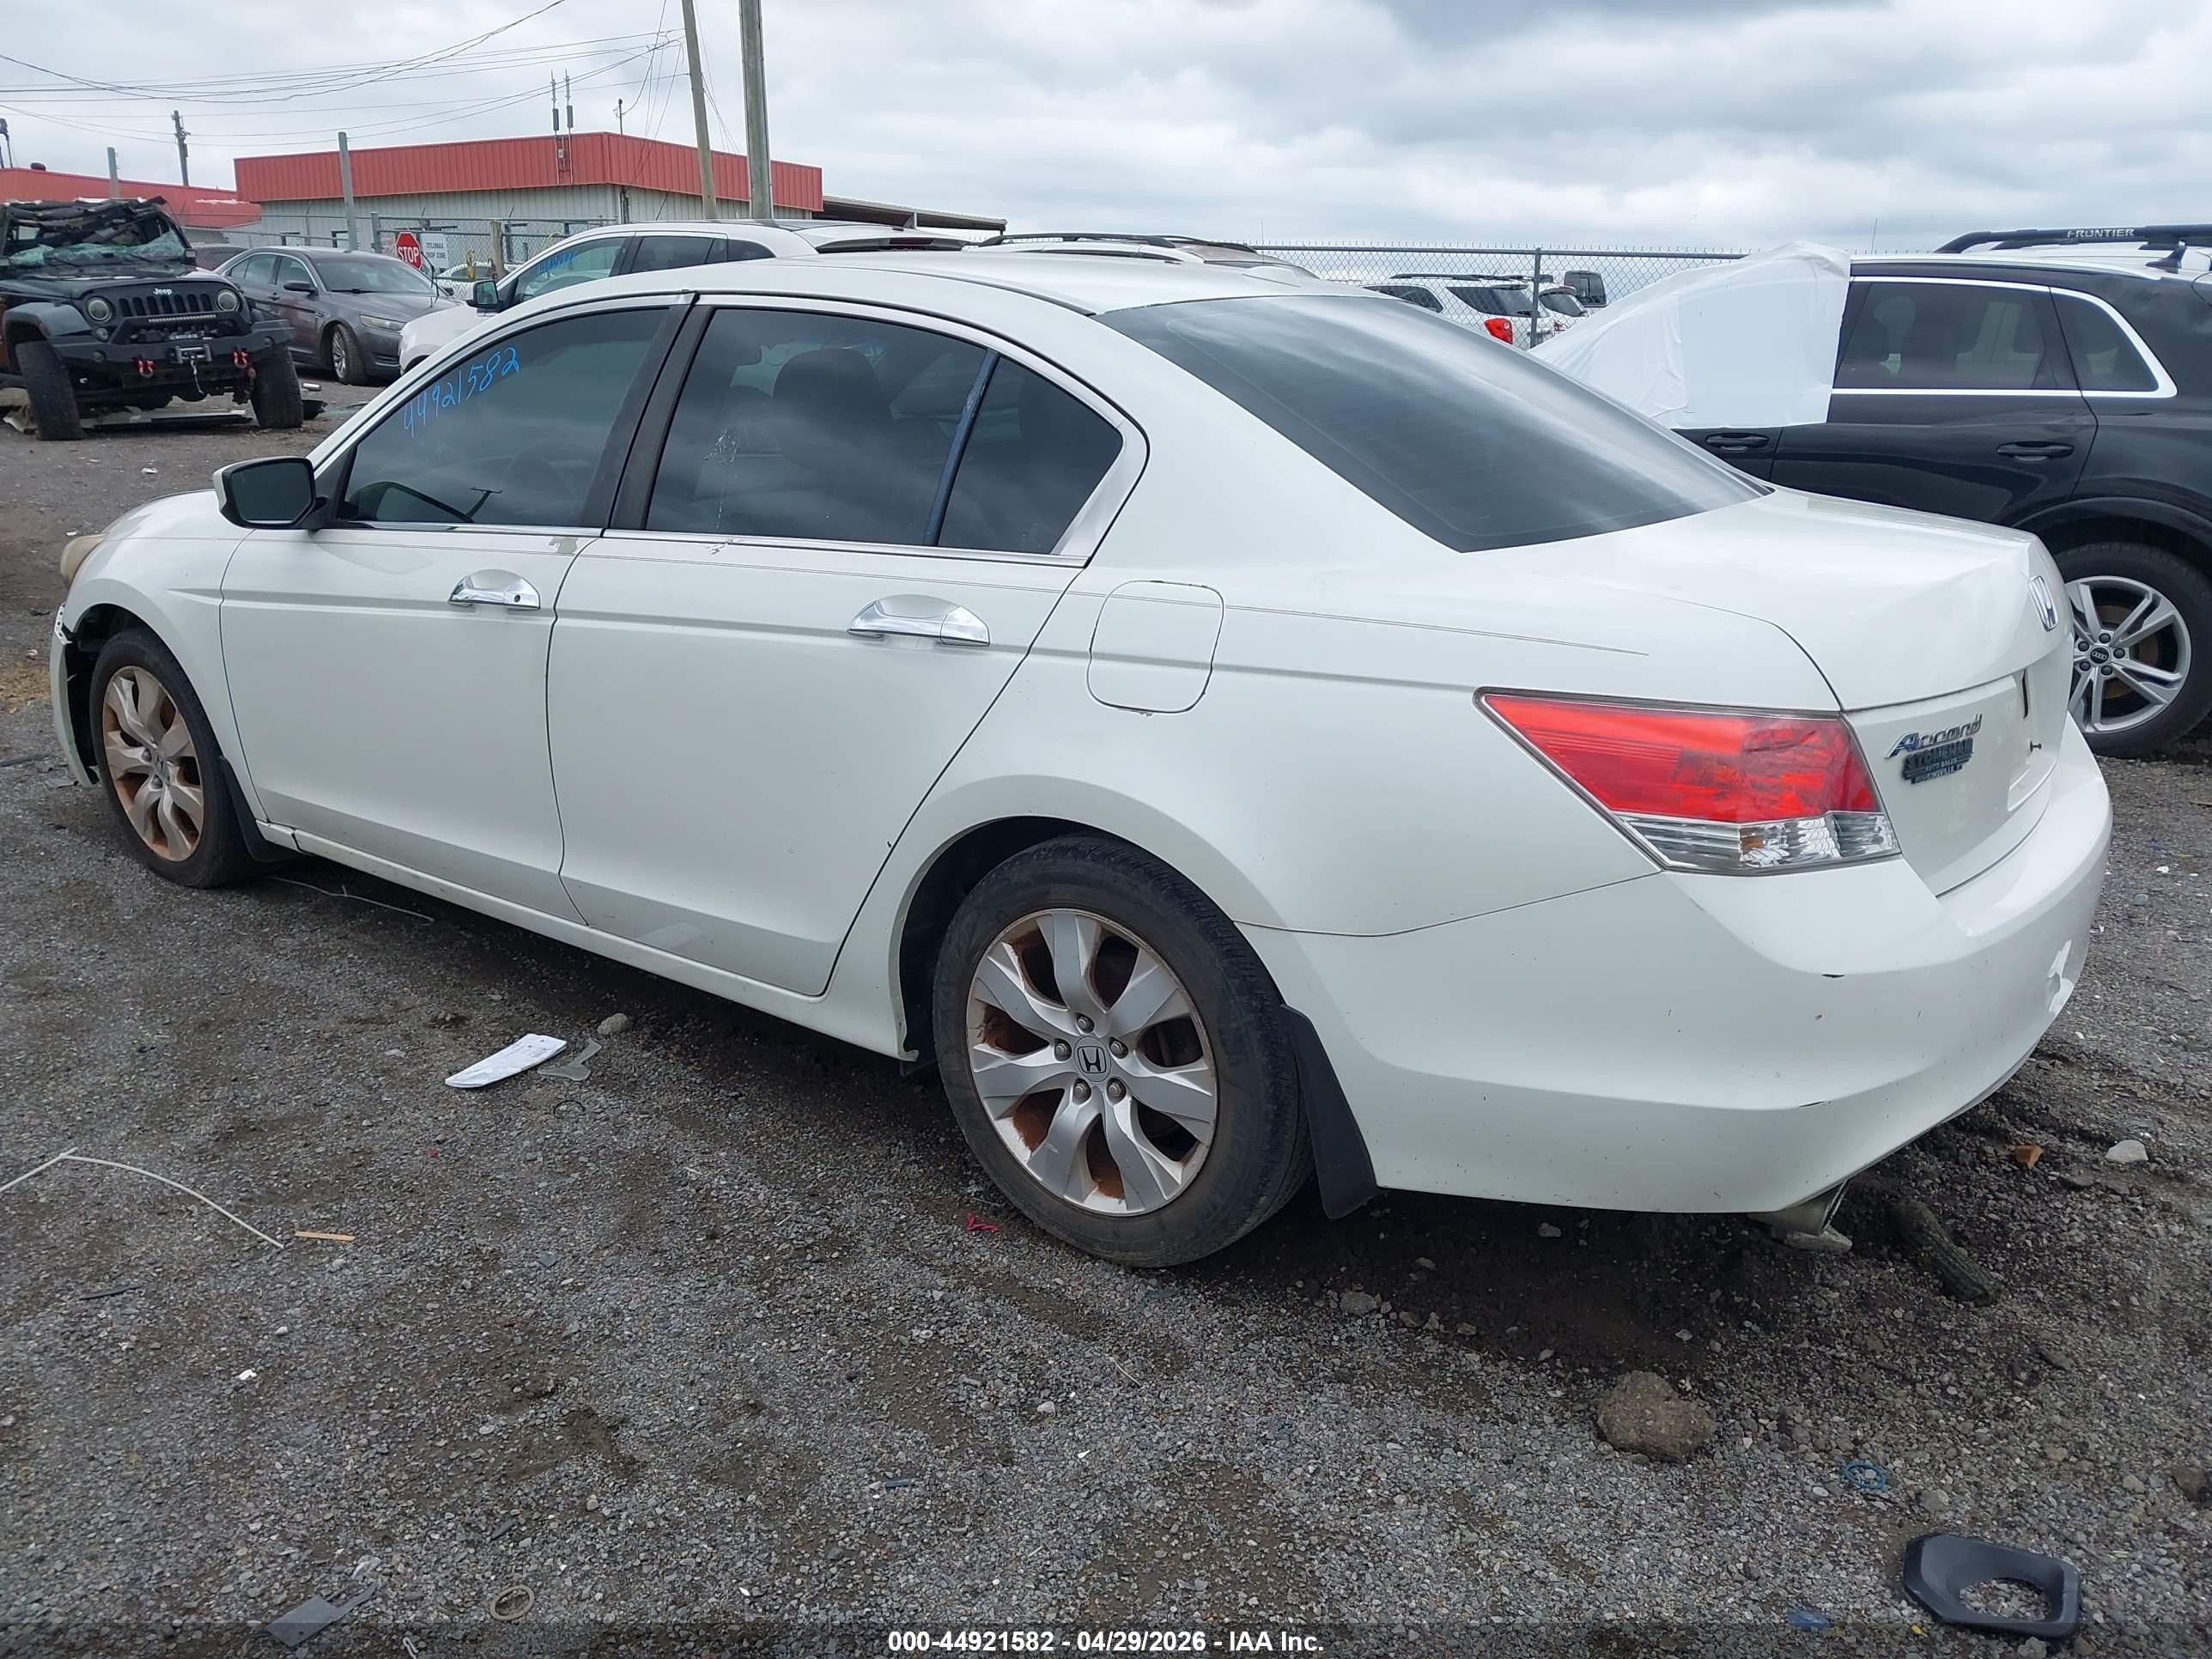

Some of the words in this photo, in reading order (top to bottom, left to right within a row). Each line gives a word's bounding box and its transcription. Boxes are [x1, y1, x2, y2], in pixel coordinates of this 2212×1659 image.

[2067, 228, 2135, 238] FRONTIER
[398, 246, 419, 263] STOP
[1884, 714, 1984, 759] Accord
